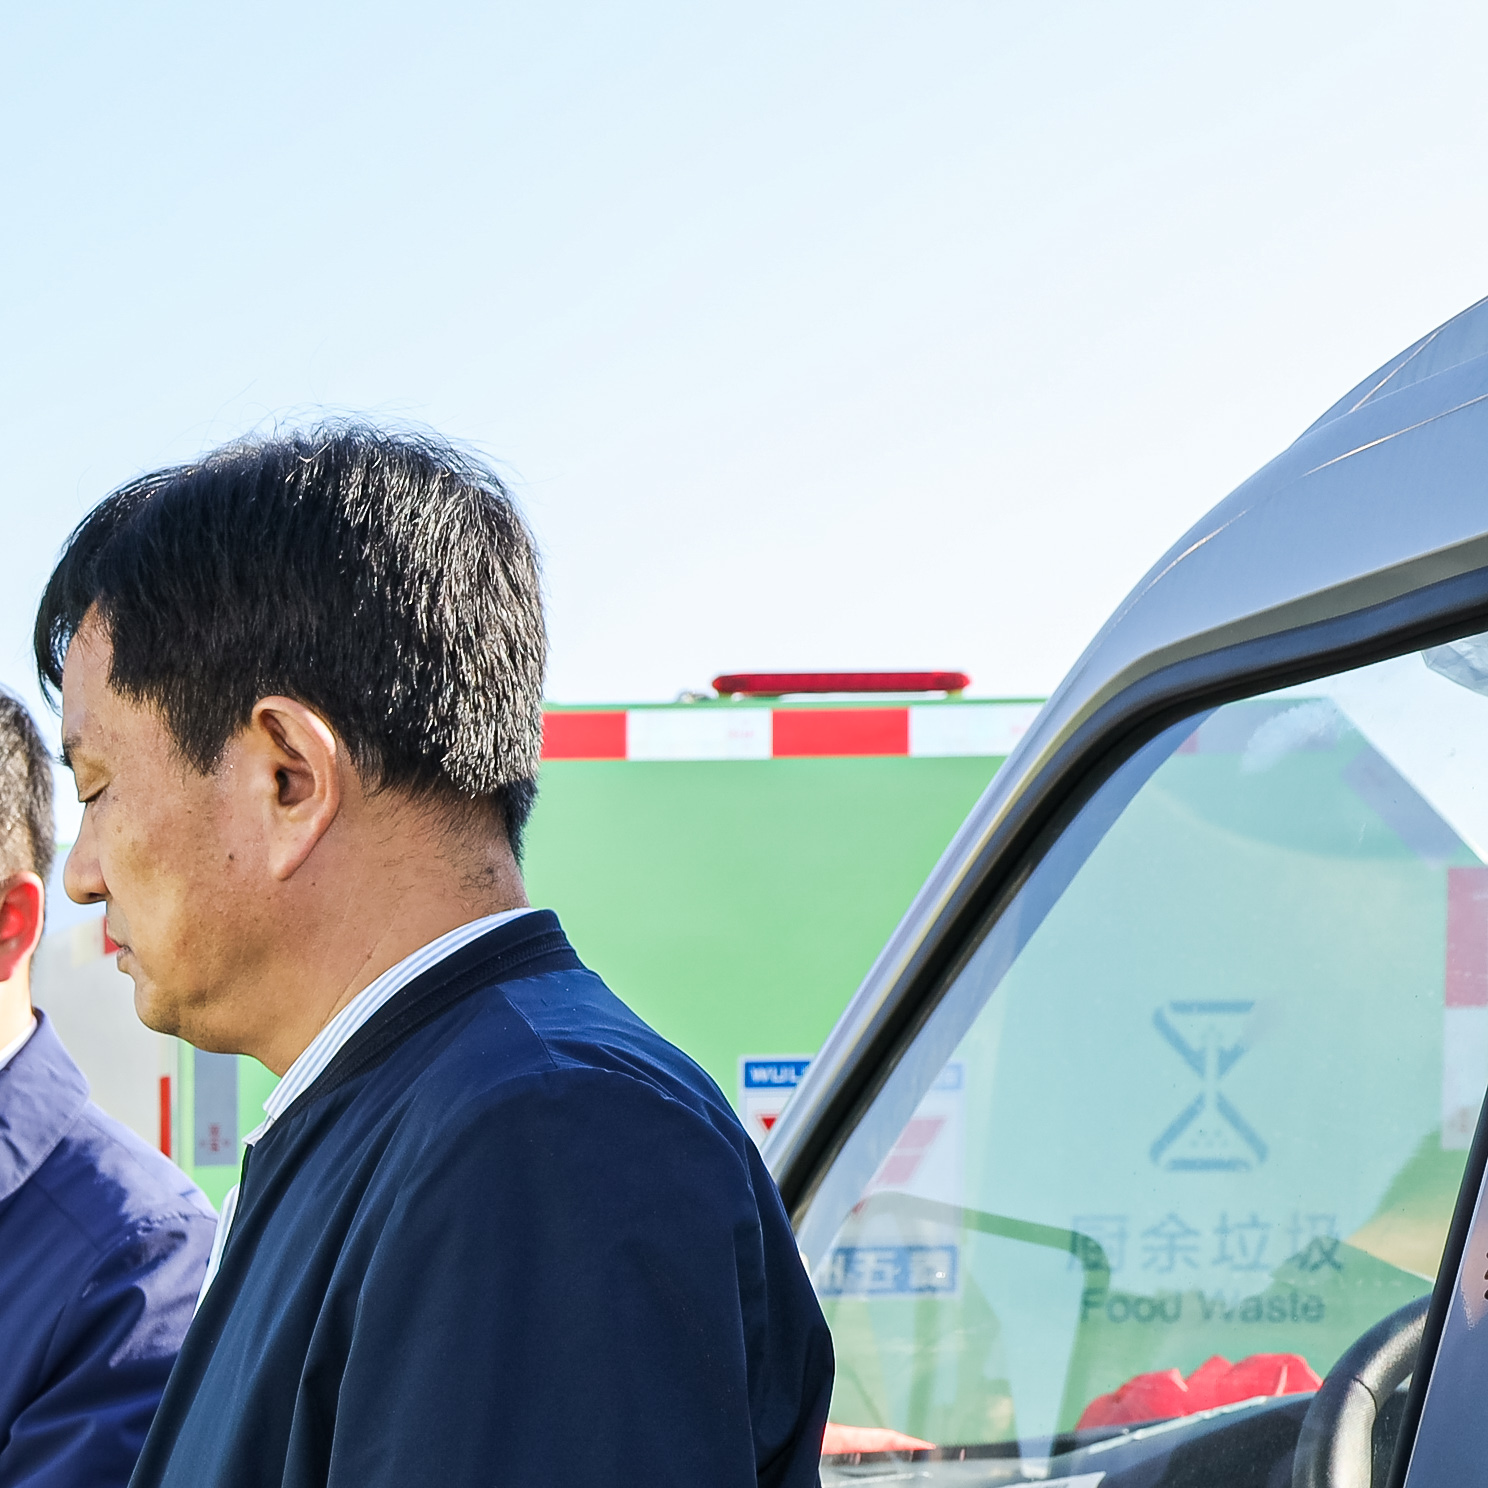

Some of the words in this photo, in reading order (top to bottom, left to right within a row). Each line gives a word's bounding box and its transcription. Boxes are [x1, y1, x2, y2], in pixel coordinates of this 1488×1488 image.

[750, 1066, 805, 1084] WUL
[1066, 1211, 1343, 1273] 厨余垃圾
[1079, 1288, 1182, 1323] Food
[1196, 1288, 1325, 1324] Waste
